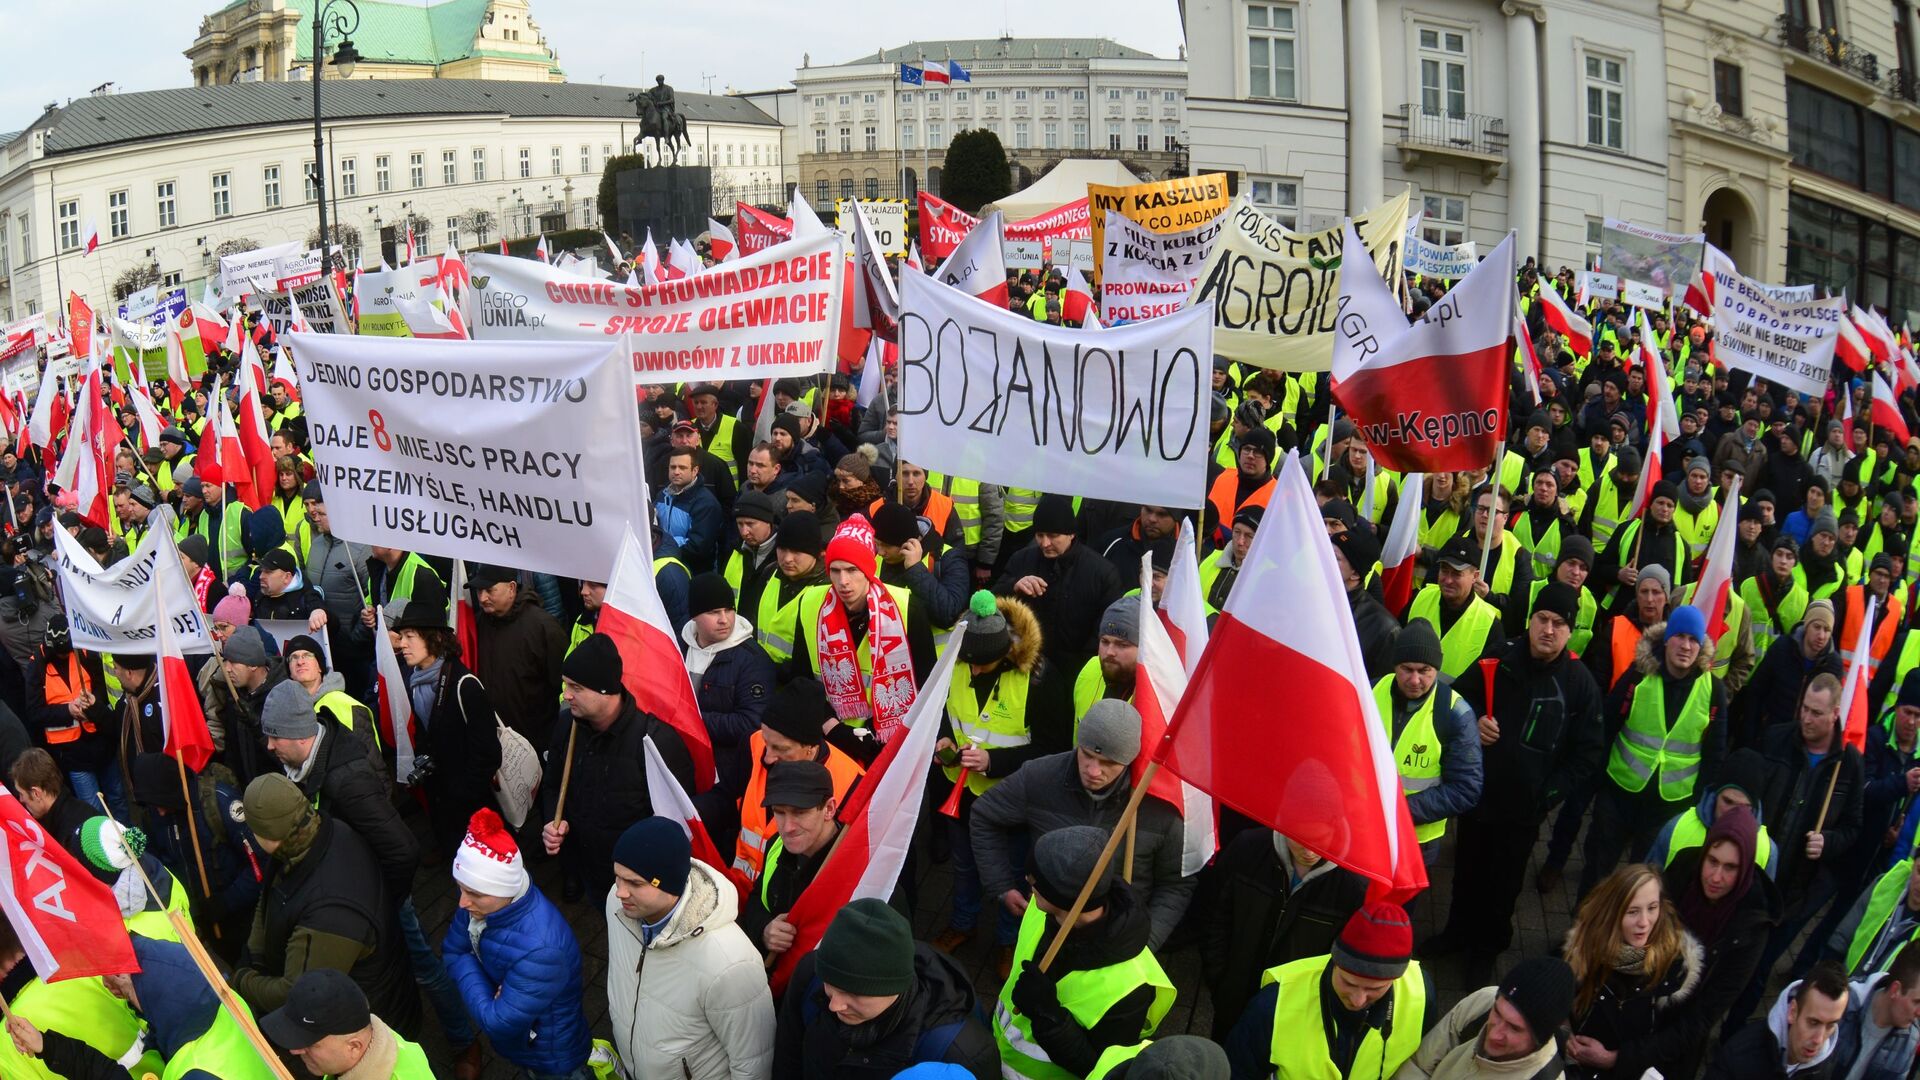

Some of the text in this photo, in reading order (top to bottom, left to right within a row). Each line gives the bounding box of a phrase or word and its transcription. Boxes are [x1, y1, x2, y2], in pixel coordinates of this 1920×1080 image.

[871, 206, 903, 214] WJAZDU
[1095, 183, 1223, 211] MY KASZUBI
[1150, 215, 1171, 229] CO
[1163, 219, 1226, 251] KURCZA
[1233, 205, 1369, 257] POWSTANE
[1108, 242, 1118, 257] Z
[1124, 245, 1178, 271] KOŚCIĄ
[1183, 253, 1193, 266] Z
[1419, 245, 1455, 261] POWIAT
[545, 251, 831, 308] CUDZE SPROWADZACIE
[1105, 282, 1187, 295] PROWADZI
[1715, 271, 1736, 289] NIE
[1781, 310, 1789, 318] W
[1793, 307, 1839, 322] POLSCE
[604, 312, 693, 335] SWOJE
[699, 293, 830, 332] OLEWACIE
[1108, 301, 1181, 321] POLSKIE
[1734, 321, 1752, 337] JAK
[1755, 325, 1770, 343] NIE
[633, 339, 823, 373] OWOCÓW Z UKRAINY
[1722, 330, 1755, 357] ŚWINIE
[1766, 351, 1797, 372] MLEKO
[1799, 362, 1829, 381] ZBYTU
[306, 361, 587, 404] JEDNO GOSPODARSTWO
[313, 408, 582, 480] DAJE 8 MIEJSC PRACY
[1356, 408, 1498, 448] w-Kępno
[316, 462, 594, 528] W PRZEMYŚLE, HANDLU
[372, 504, 522, 549] I USŁUGACH
